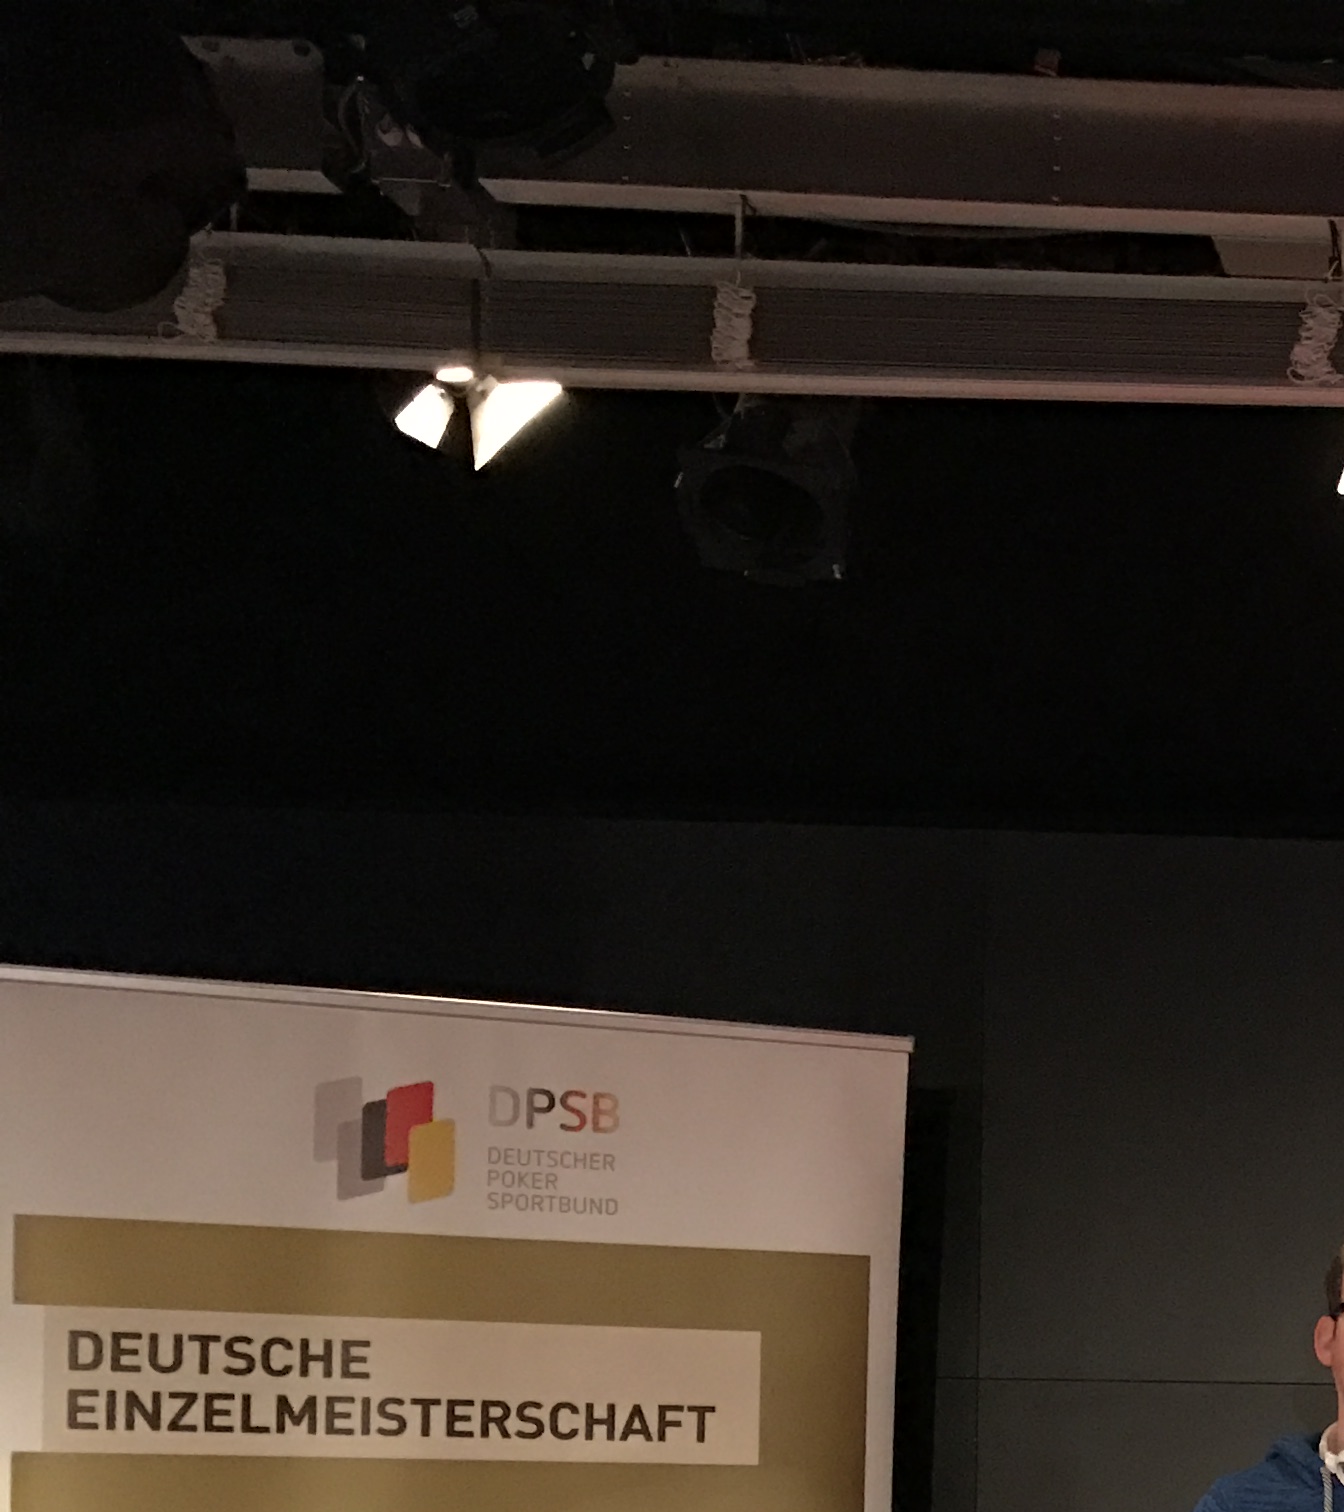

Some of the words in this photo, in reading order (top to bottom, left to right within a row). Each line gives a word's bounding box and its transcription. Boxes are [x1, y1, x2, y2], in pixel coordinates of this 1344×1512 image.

[488, 1085, 620, 1134] DPSB
[487, 1146, 616, 1172] DEUTSCHER
[487, 1169, 558, 1190] POKER
[487, 1191, 618, 1216] SPORTBUND
[67, 1330, 371, 1379] DEUTSCHE
[66, 1388, 717, 1443] EINZELMEISTERSCHAFT
